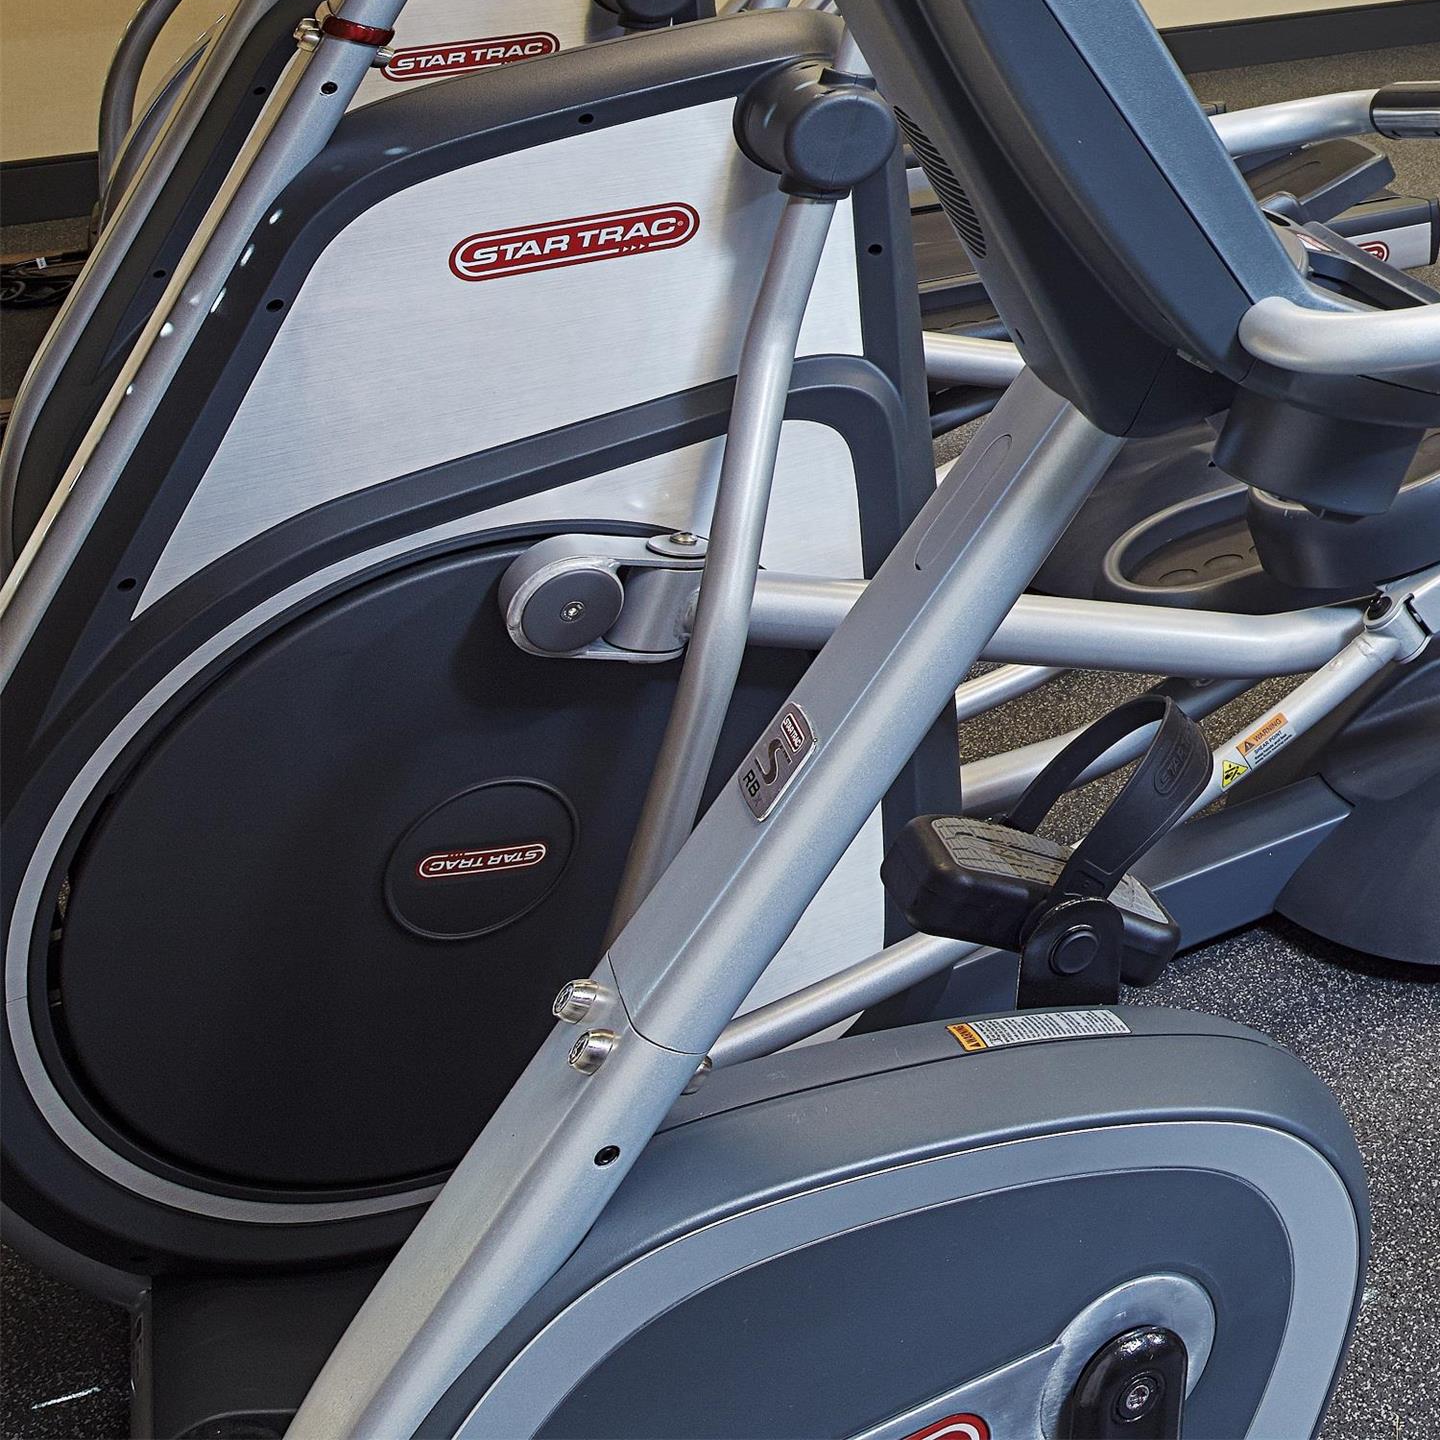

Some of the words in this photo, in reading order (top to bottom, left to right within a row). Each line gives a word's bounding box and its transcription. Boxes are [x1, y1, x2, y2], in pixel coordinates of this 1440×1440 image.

[397, 51, 466, 70] STAR
[471, 42, 543, 61] TRAC
[473, 235, 570, 262] STAR
[1254, 719, 1281, 741] WARNING
[429, 858, 483, 871] TRAC
[488, 852, 537, 865] STAR
